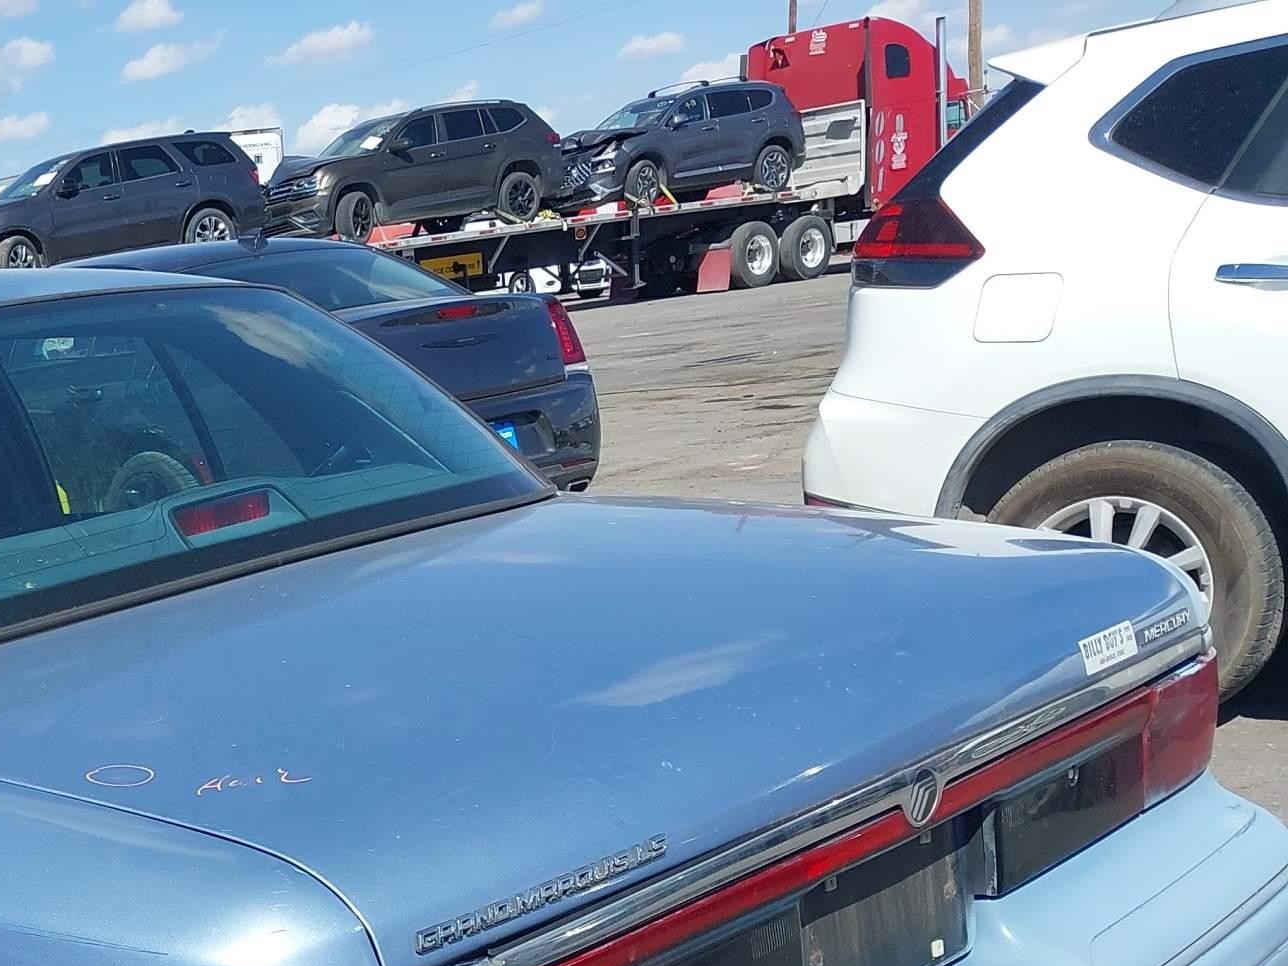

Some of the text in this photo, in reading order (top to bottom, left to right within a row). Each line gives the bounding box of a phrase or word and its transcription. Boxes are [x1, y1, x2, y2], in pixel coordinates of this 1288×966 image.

[1144, 608, 1191, 643] MERCURY
[1082, 635, 1103, 661] BILLY
[415, 833, 668, 955] GRAND MARQUIS LS
